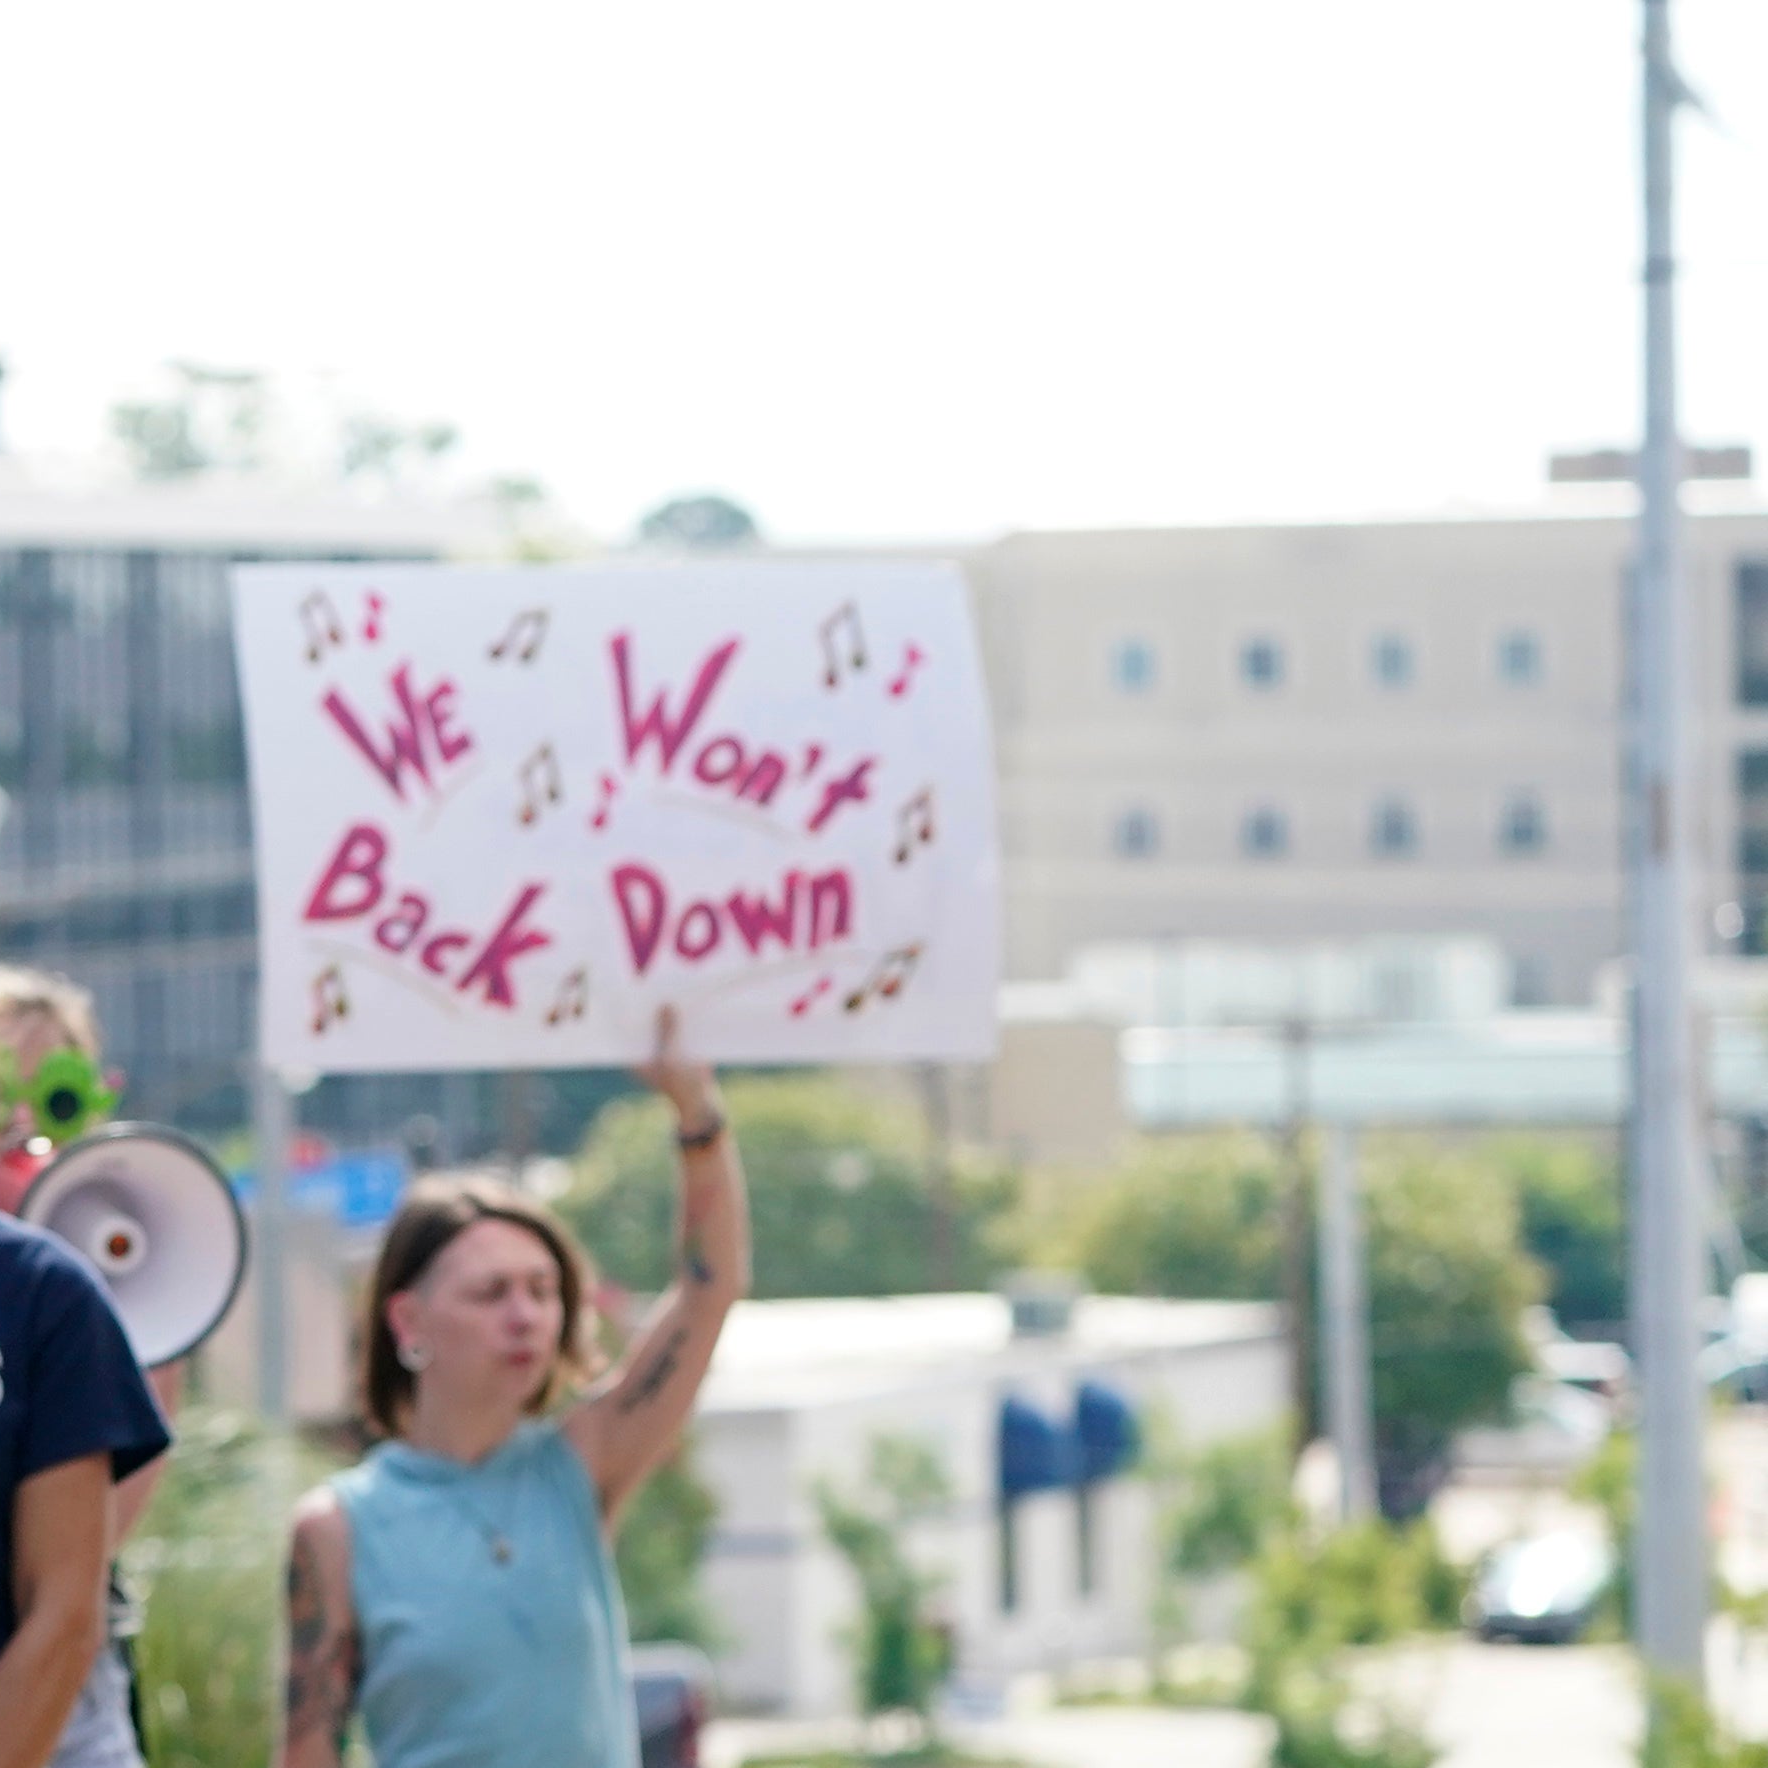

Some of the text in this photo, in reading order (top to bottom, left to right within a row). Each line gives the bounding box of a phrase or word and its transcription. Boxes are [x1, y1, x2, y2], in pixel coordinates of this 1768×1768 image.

[322, 632, 877, 834] WE Won't
[303, 822, 851, 1012] Back Down
